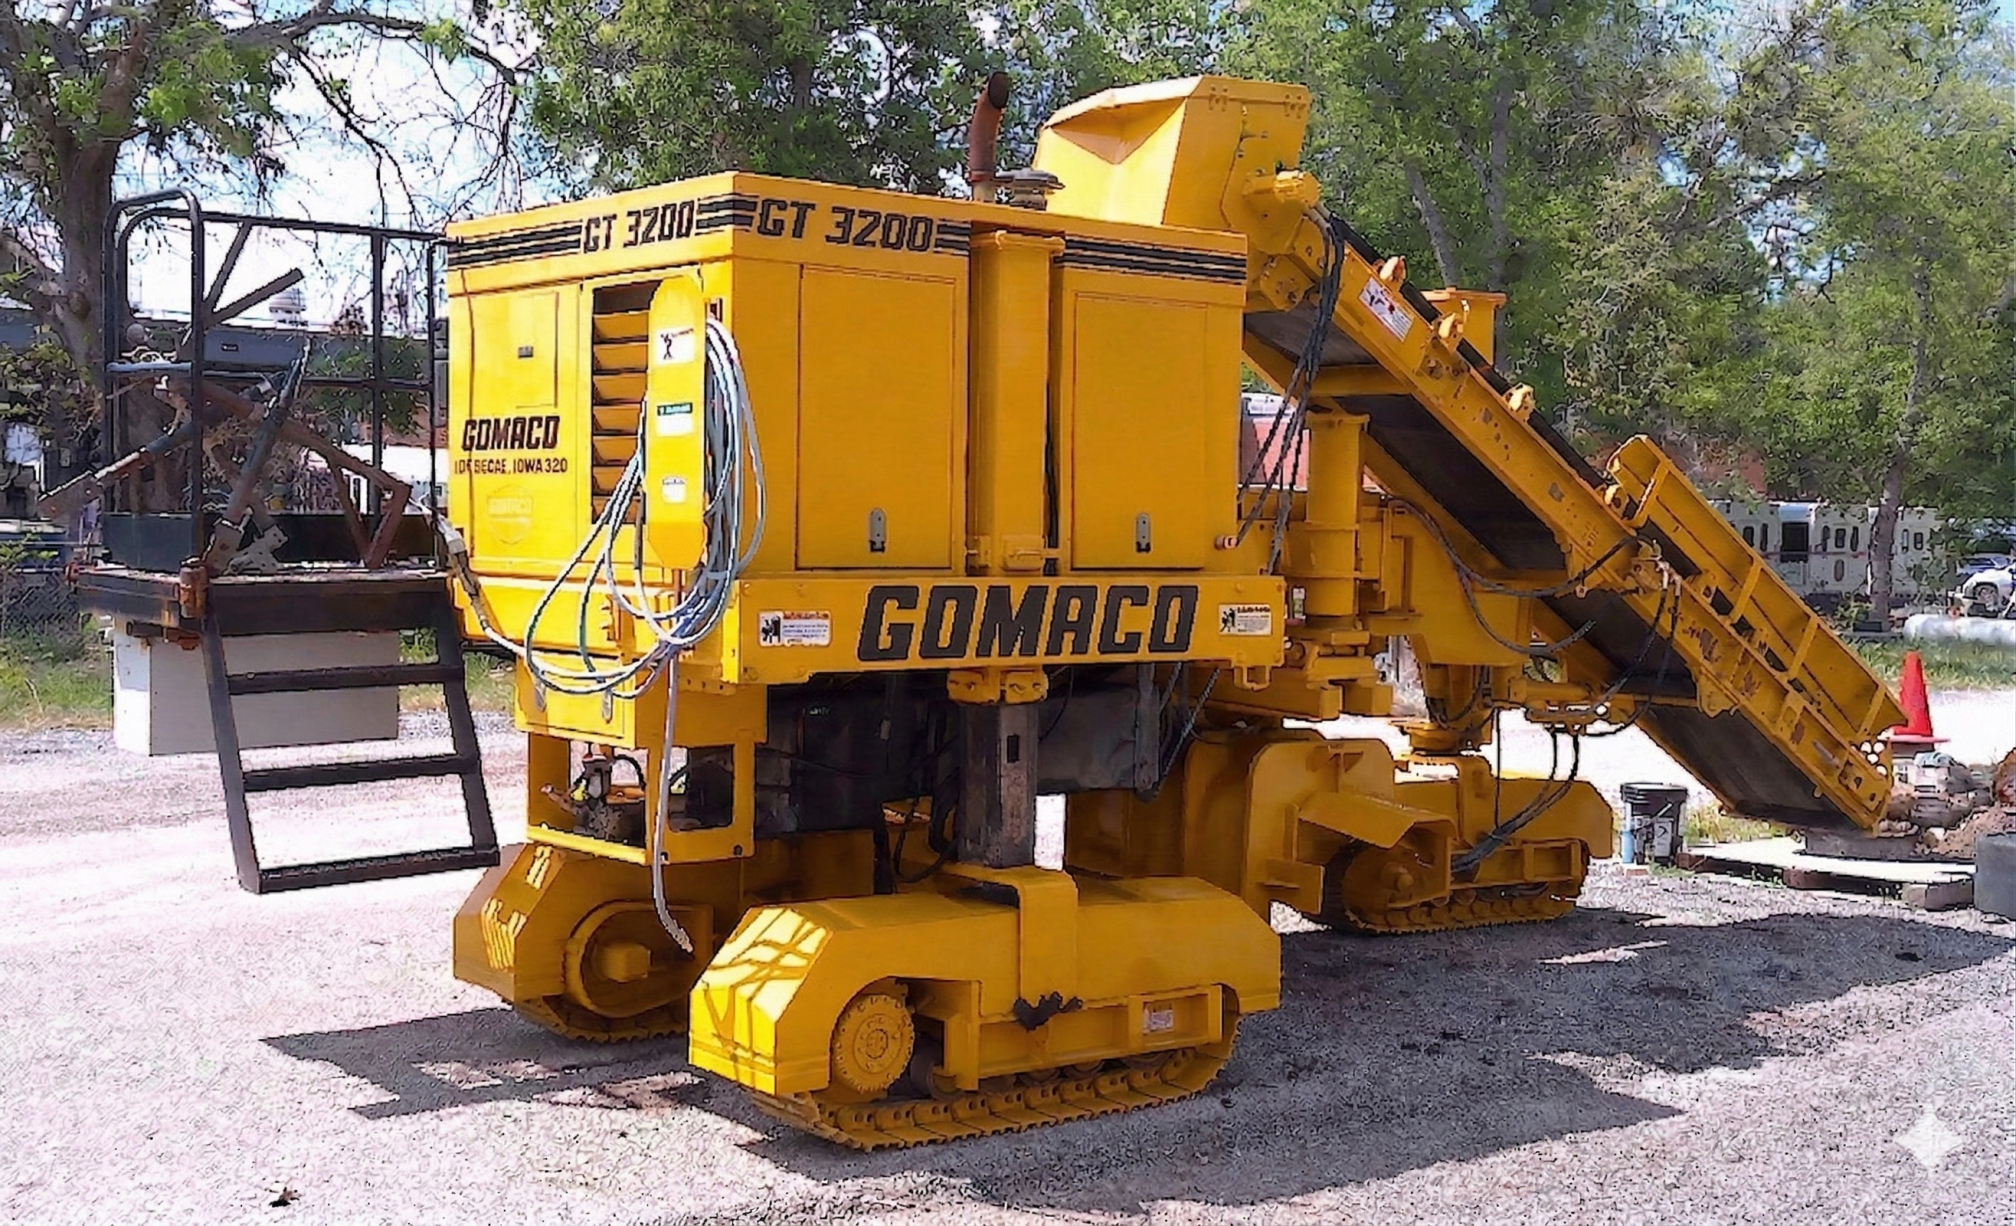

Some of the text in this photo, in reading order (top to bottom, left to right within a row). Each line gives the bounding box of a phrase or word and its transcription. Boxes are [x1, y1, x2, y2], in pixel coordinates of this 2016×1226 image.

[583, 200, 695, 254] GT 3200
[757, 198, 934, 252] GT 3200
[461, 415, 560, 452] GOMACO
[857, 585, 1199, 661] GOMACO
